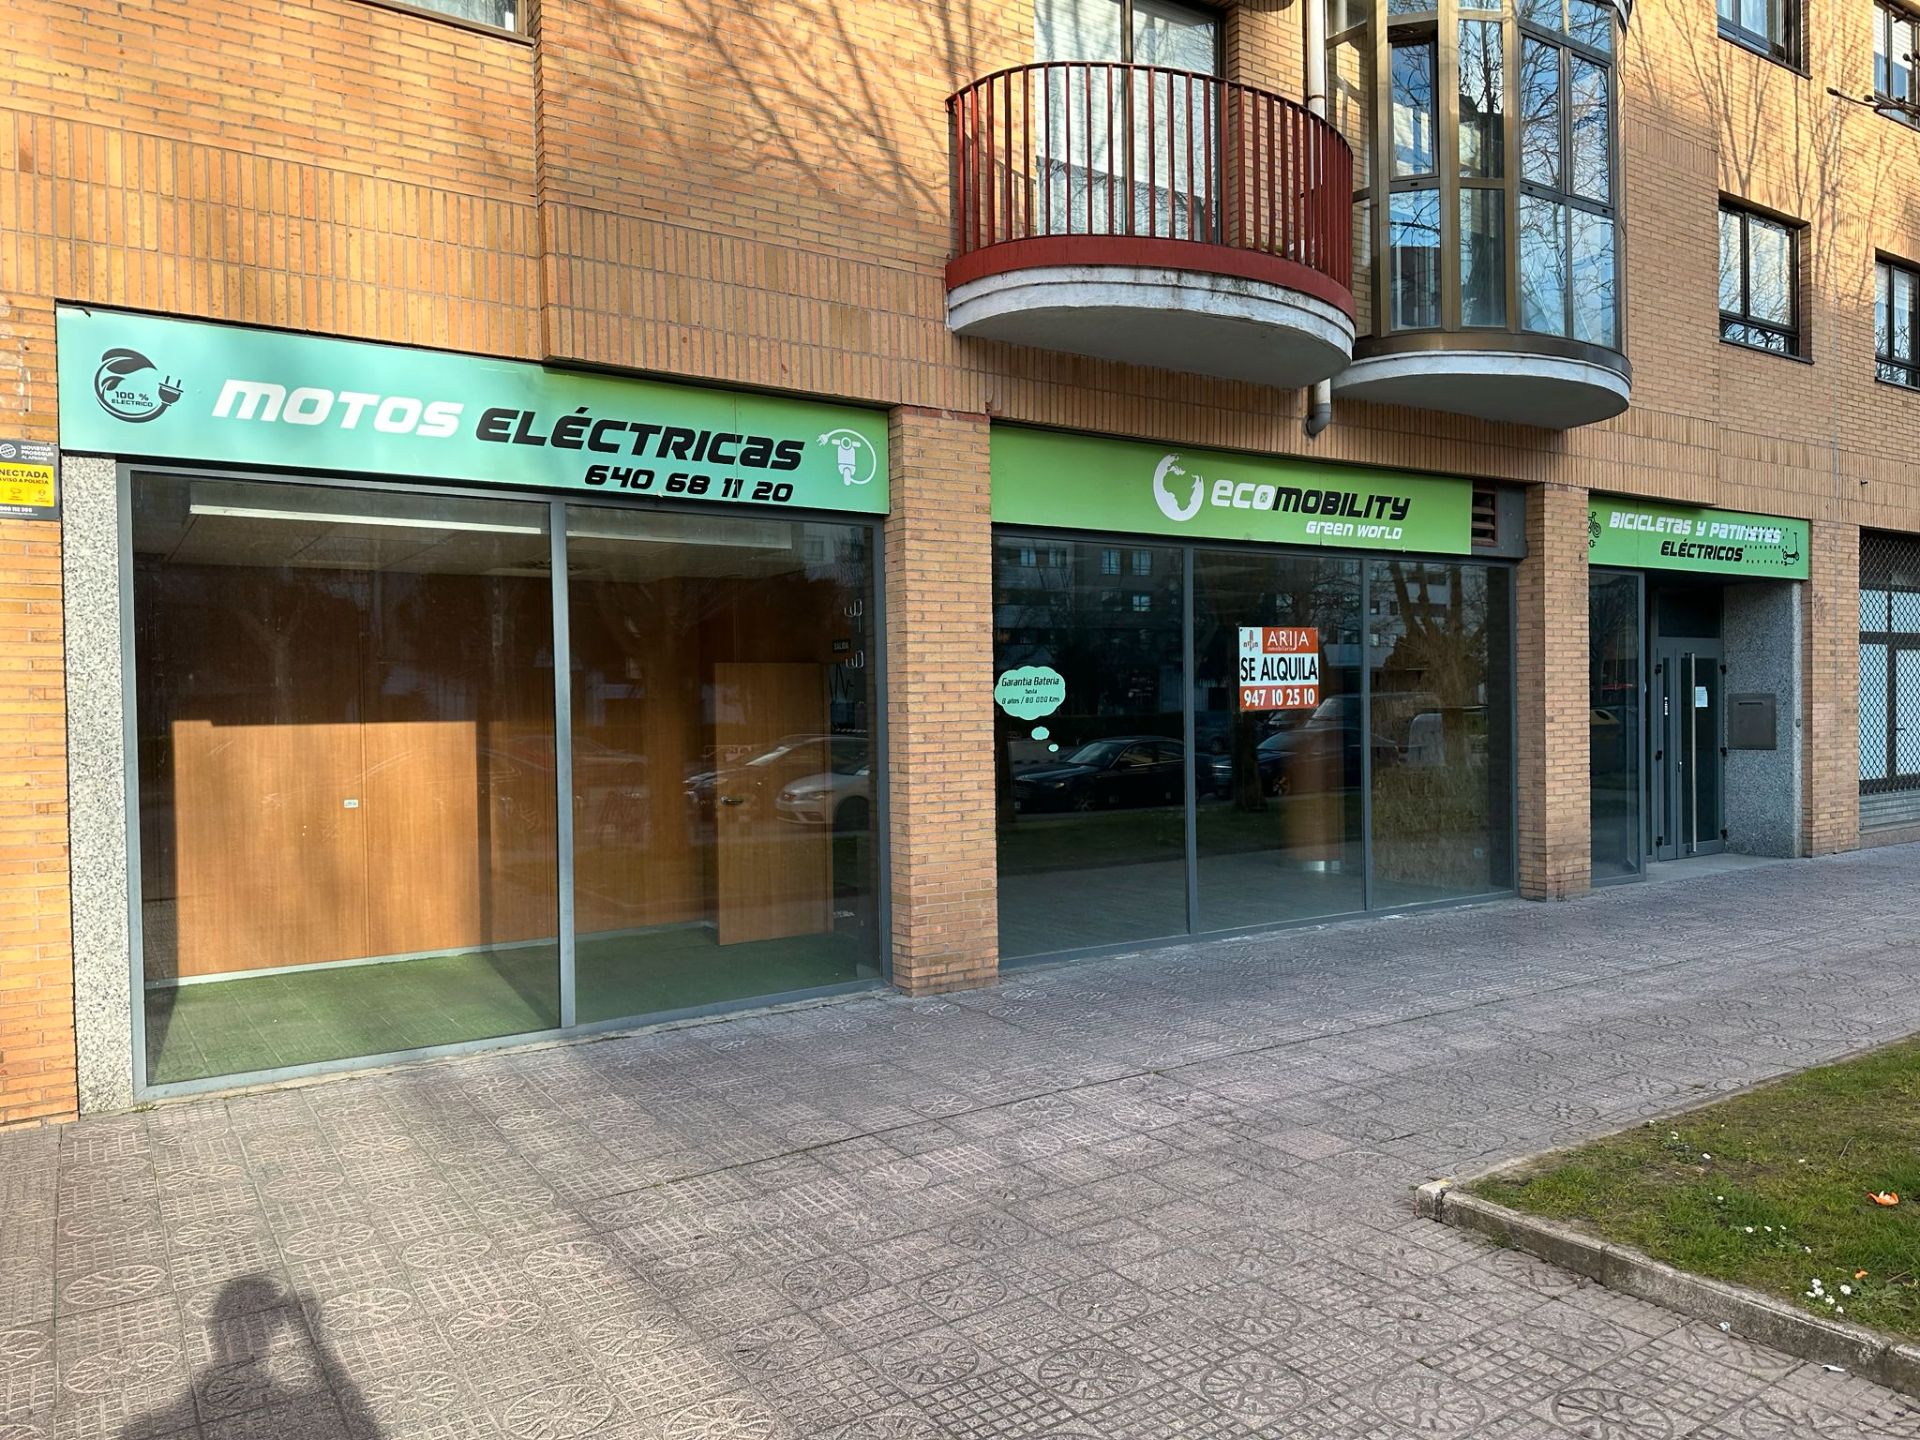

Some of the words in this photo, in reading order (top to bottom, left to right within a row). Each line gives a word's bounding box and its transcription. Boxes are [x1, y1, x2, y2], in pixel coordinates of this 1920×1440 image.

[115, 390, 135, 400] 100
[211, 378, 465, 438] MOTOS
[584, 464, 655, 490] 640
[665, 472, 711, 496] 68
[721, 478, 744, 499] 11
[750, 481, 793, 502] 20
[1660, 538, 1744, 562] ELÉCTRICOS
[1267, 630, 1310, 651] ARIJA
[1240, 656, 1256, 681] SE
[1260, 656, 1318, 681] ALQUILA
[1243, 689, 1267, 707] 947
[1271, 689, 1283, 706] 10
[1286, 688, 1300, 706] 25
[1303, 687, 1315, 705] 10
